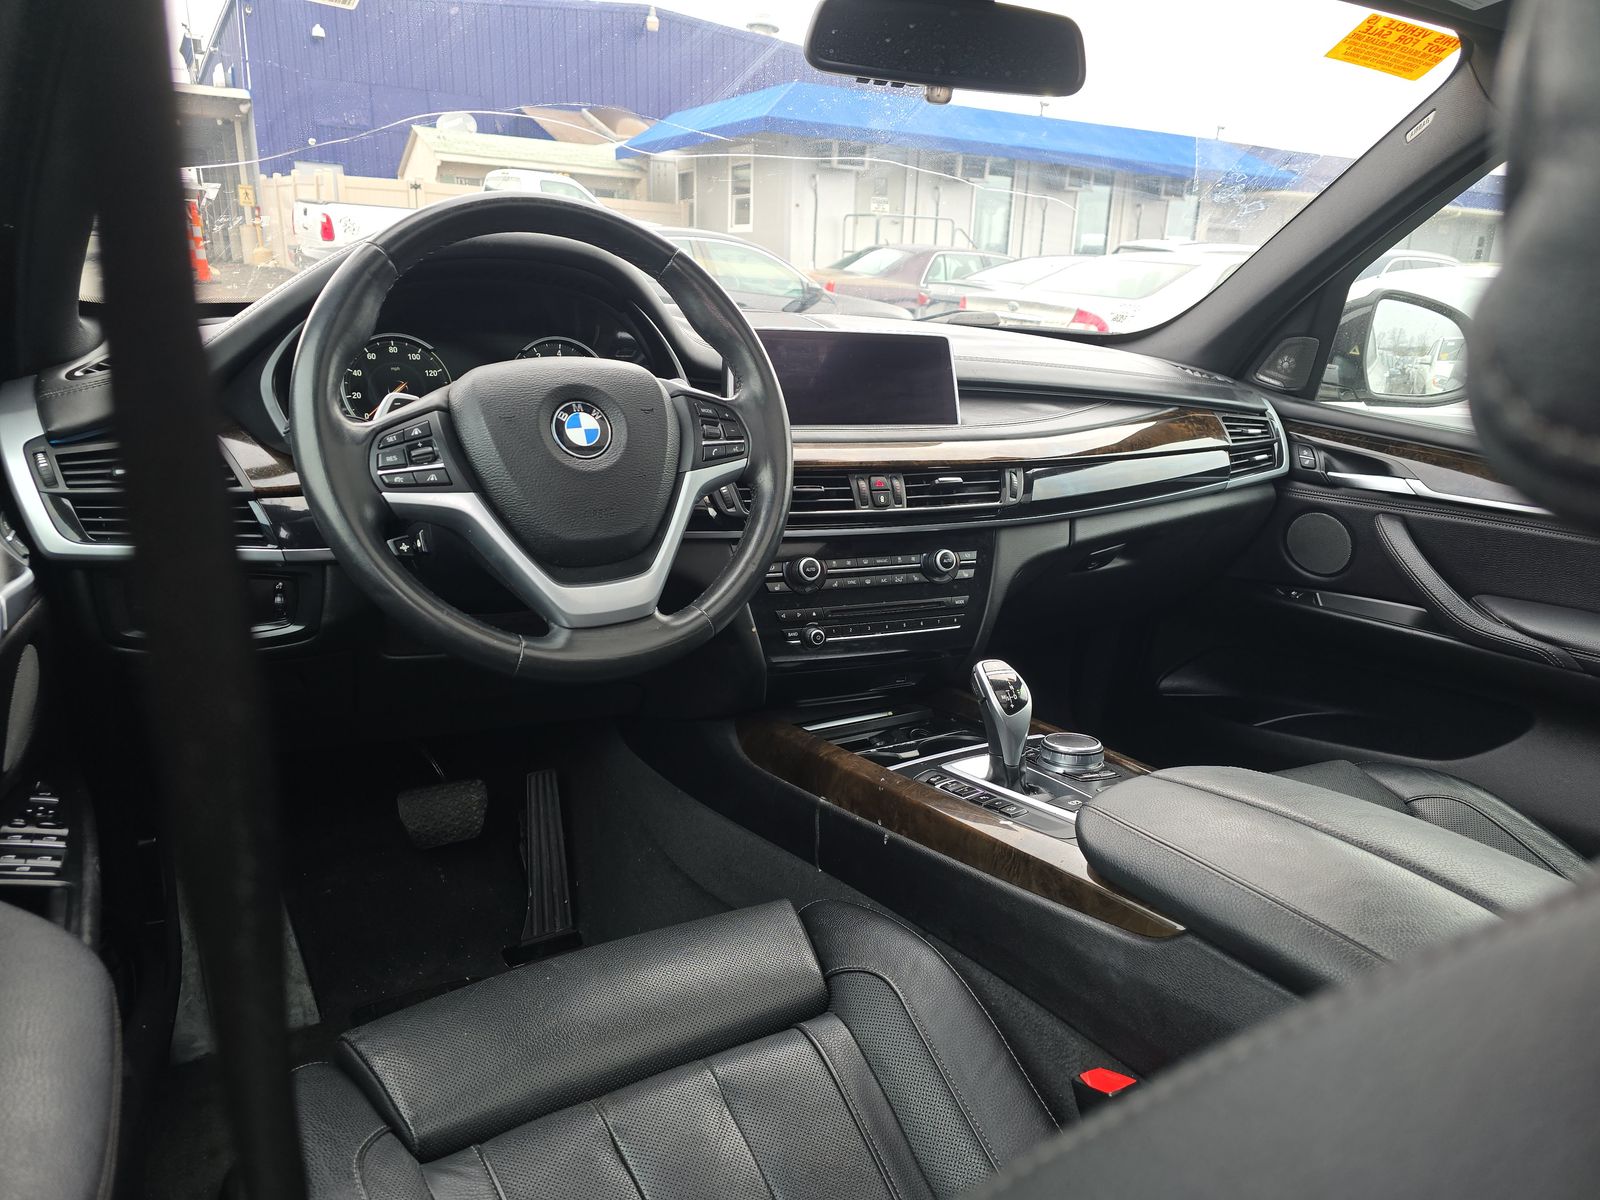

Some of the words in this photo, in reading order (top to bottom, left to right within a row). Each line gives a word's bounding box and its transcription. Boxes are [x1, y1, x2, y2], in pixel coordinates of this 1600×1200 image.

[556, 349, 562, 357] 4
[557, 403, 602, 422] BMW
[386, 435, 397, 443] SET
